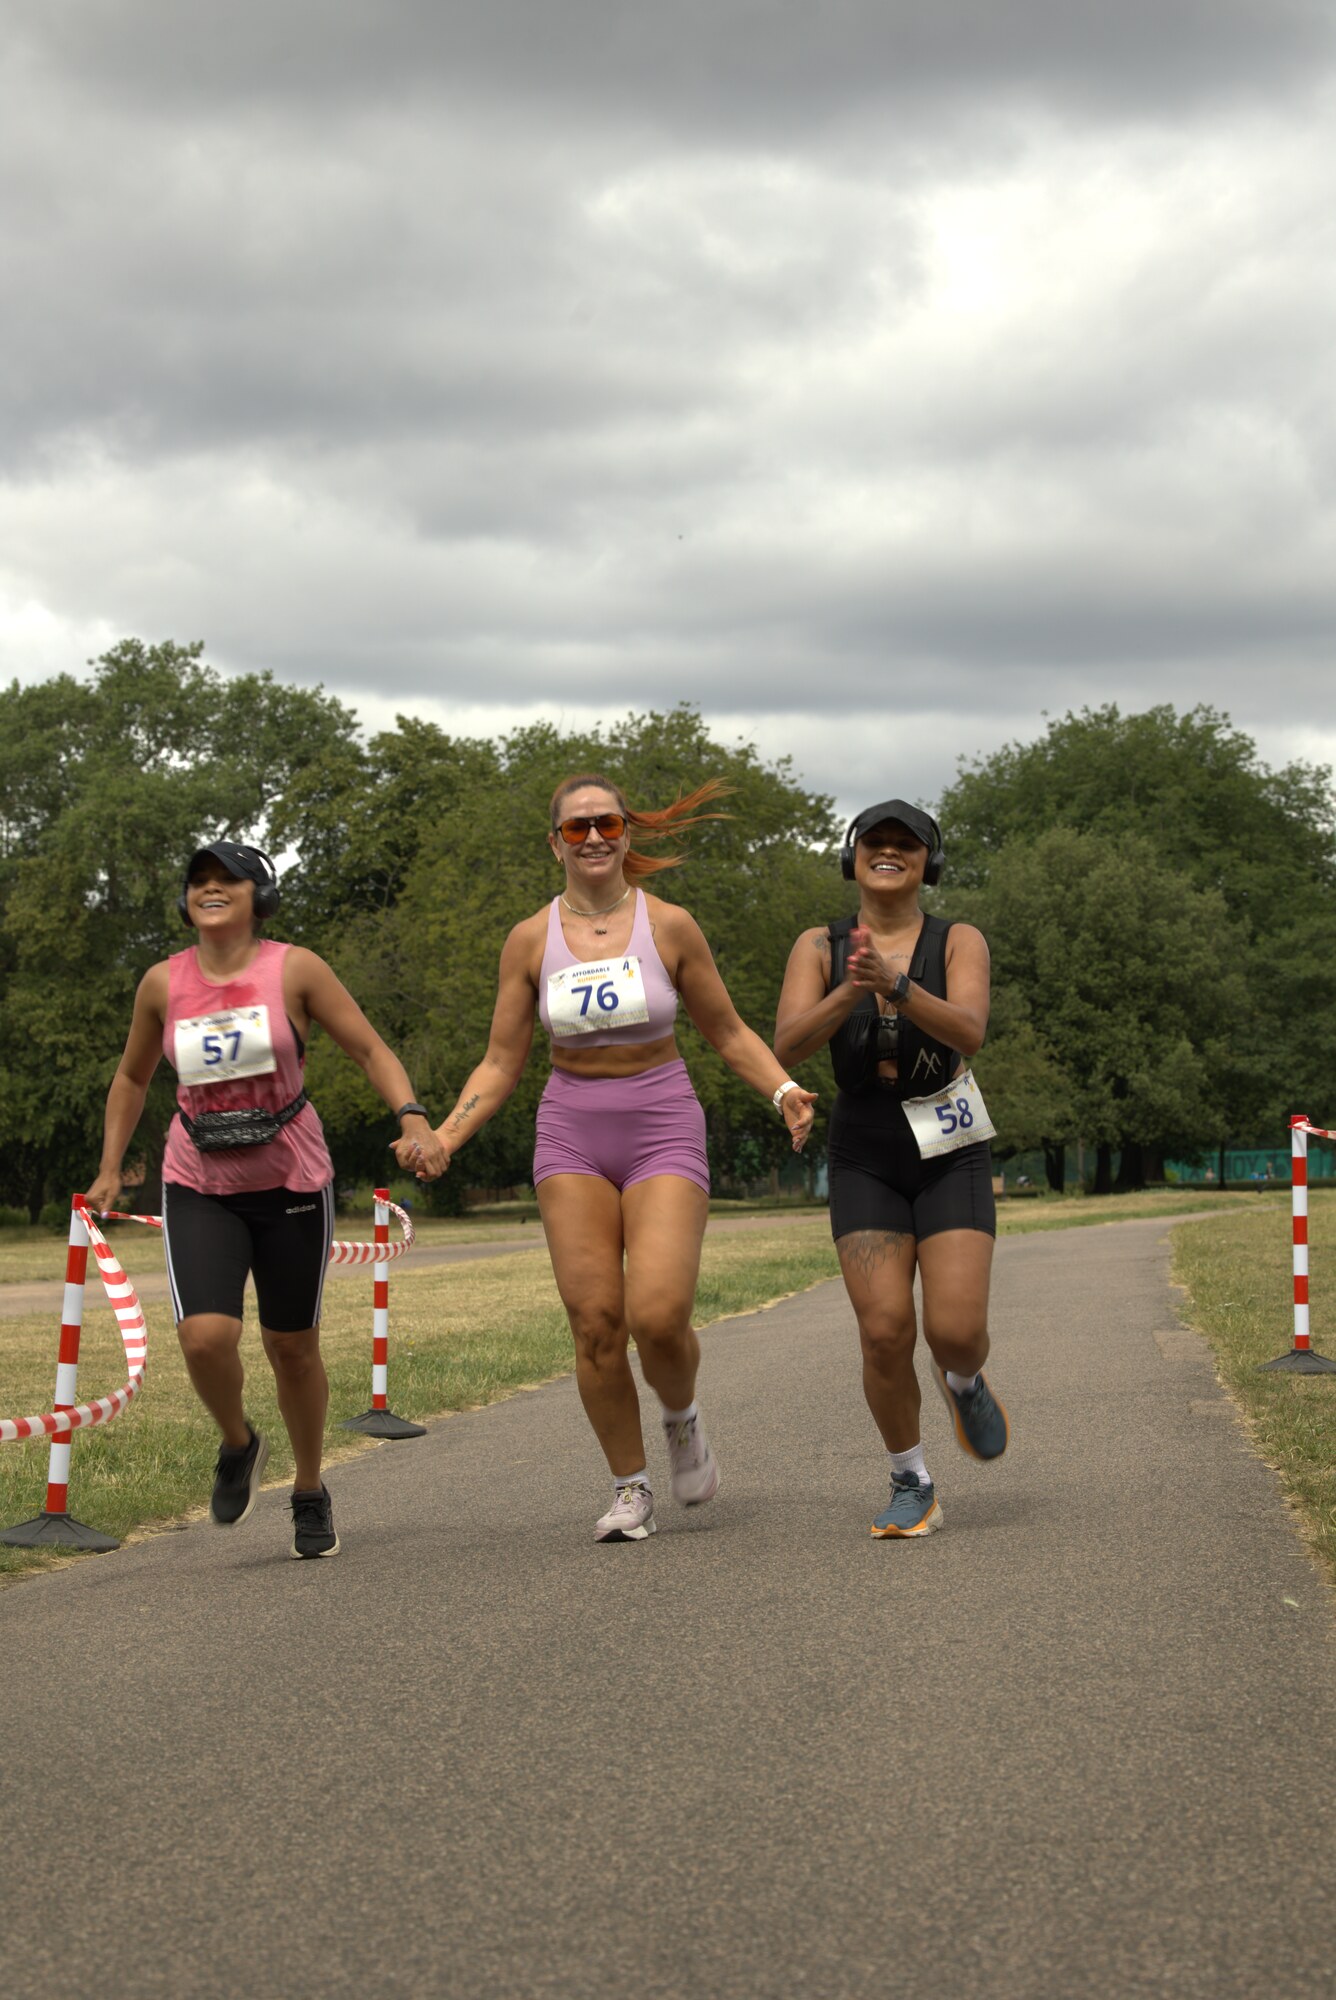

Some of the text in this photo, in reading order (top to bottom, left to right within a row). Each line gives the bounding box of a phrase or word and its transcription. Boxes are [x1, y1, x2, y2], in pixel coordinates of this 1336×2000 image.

[572, 966, 610, 978] AFFORDABLE
[571, 980, 619, 1016] 76
[203, 1030, 242, 1067] 57
[935, 1098, 973, 1134] 58
